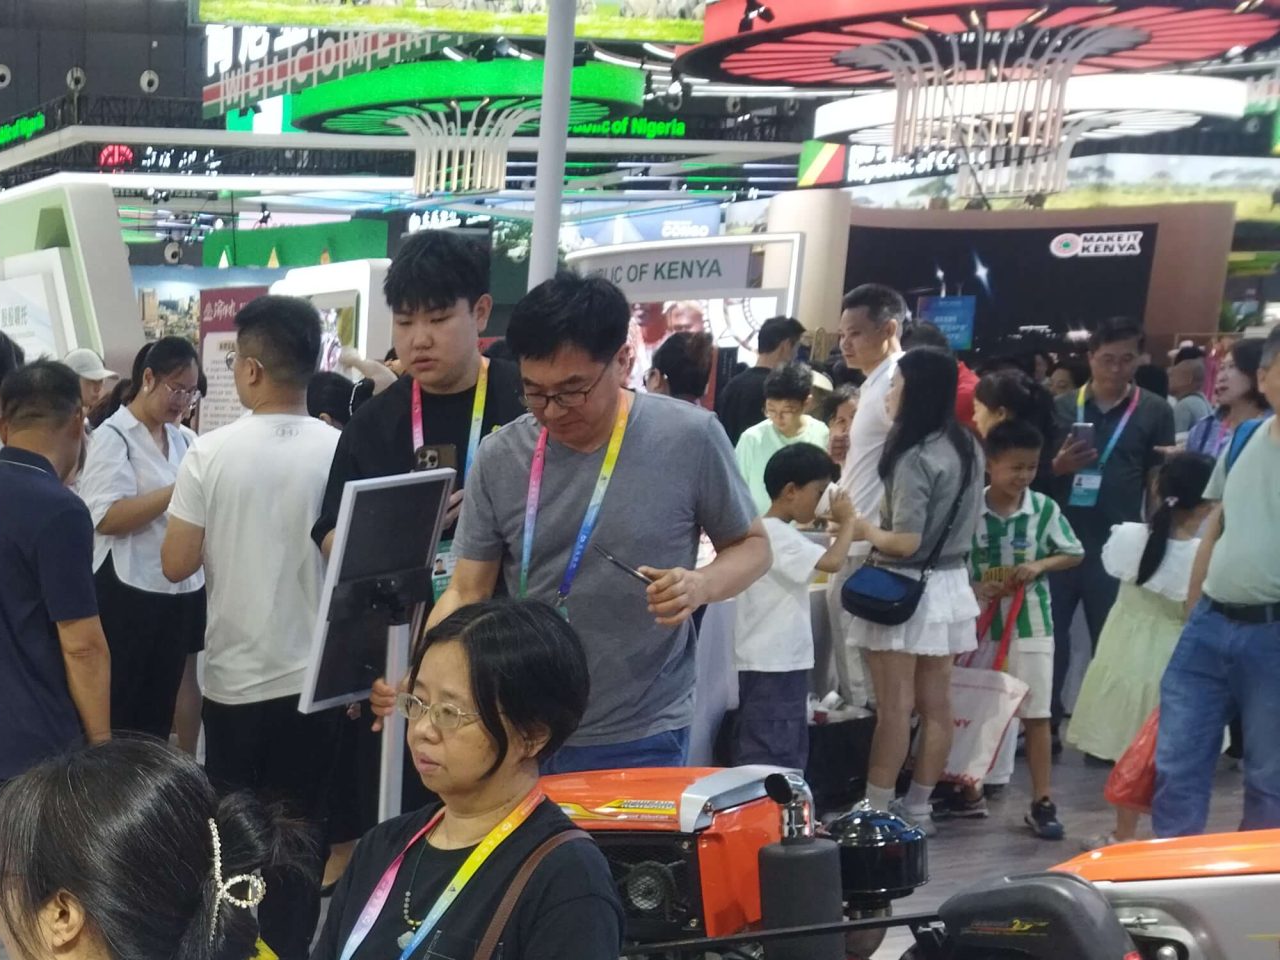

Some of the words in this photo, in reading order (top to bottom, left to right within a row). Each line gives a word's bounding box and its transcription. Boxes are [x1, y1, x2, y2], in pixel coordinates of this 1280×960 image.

[611, 117, 629, 135] of
[631, 117, 686, 139] Nigeria
[1083, 234, 1124, 243] MAKE
[1126, 233, 1139, 242] IT
[1081, 243, 1138, 253] KENYA
[626, 263, 649, 283] OF
[654, 259, 722, 281] KENYA
